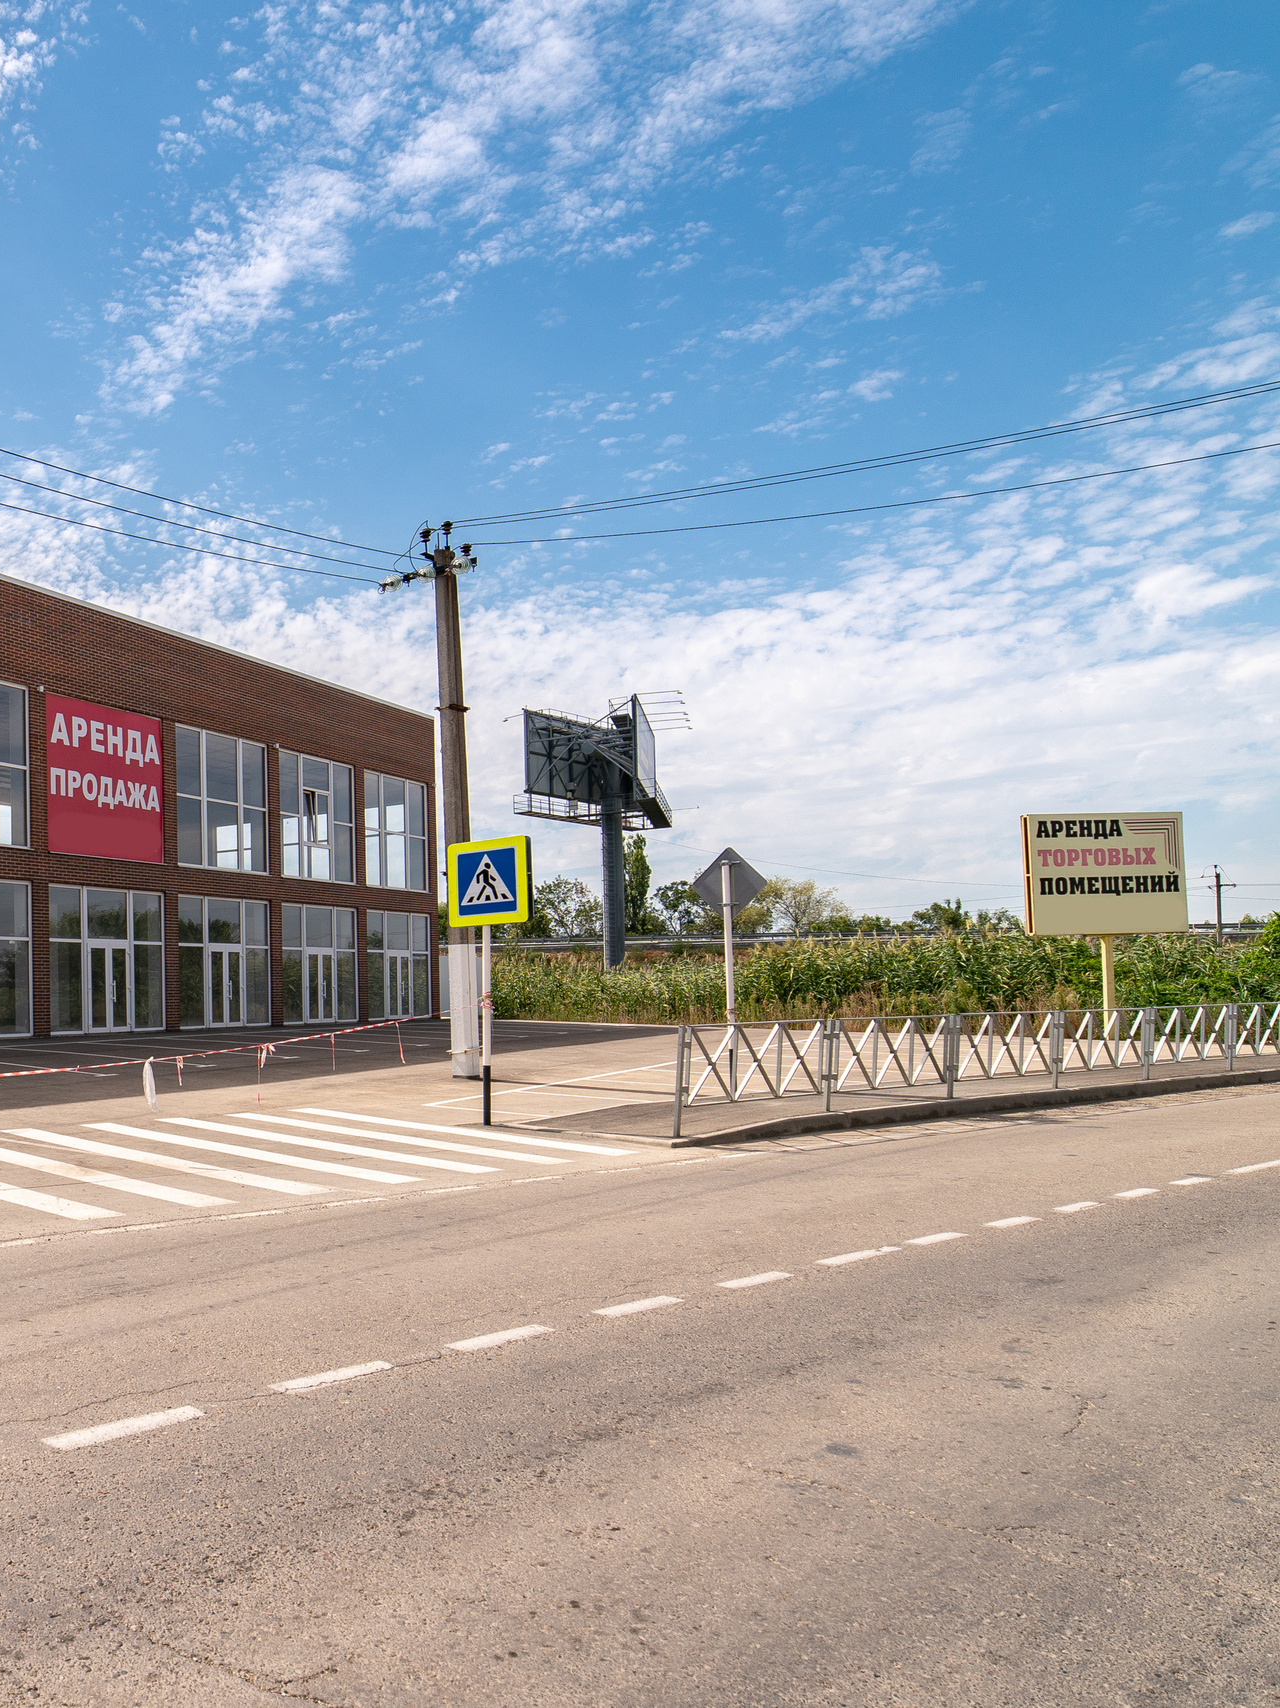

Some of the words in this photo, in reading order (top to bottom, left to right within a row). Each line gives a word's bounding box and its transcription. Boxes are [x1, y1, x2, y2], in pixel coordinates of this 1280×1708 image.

[50, 712, 160, 768] АРЕНДА
[50, 766, 160, 813] ПРОДАЖА
[1036, 819, 1123, 840] АРЕНДА
[1037, 847, 1157, 867] ТОРГОВЫХ
[1039, 871, 1180, 896] ПОМЕЩЕНИЙ
